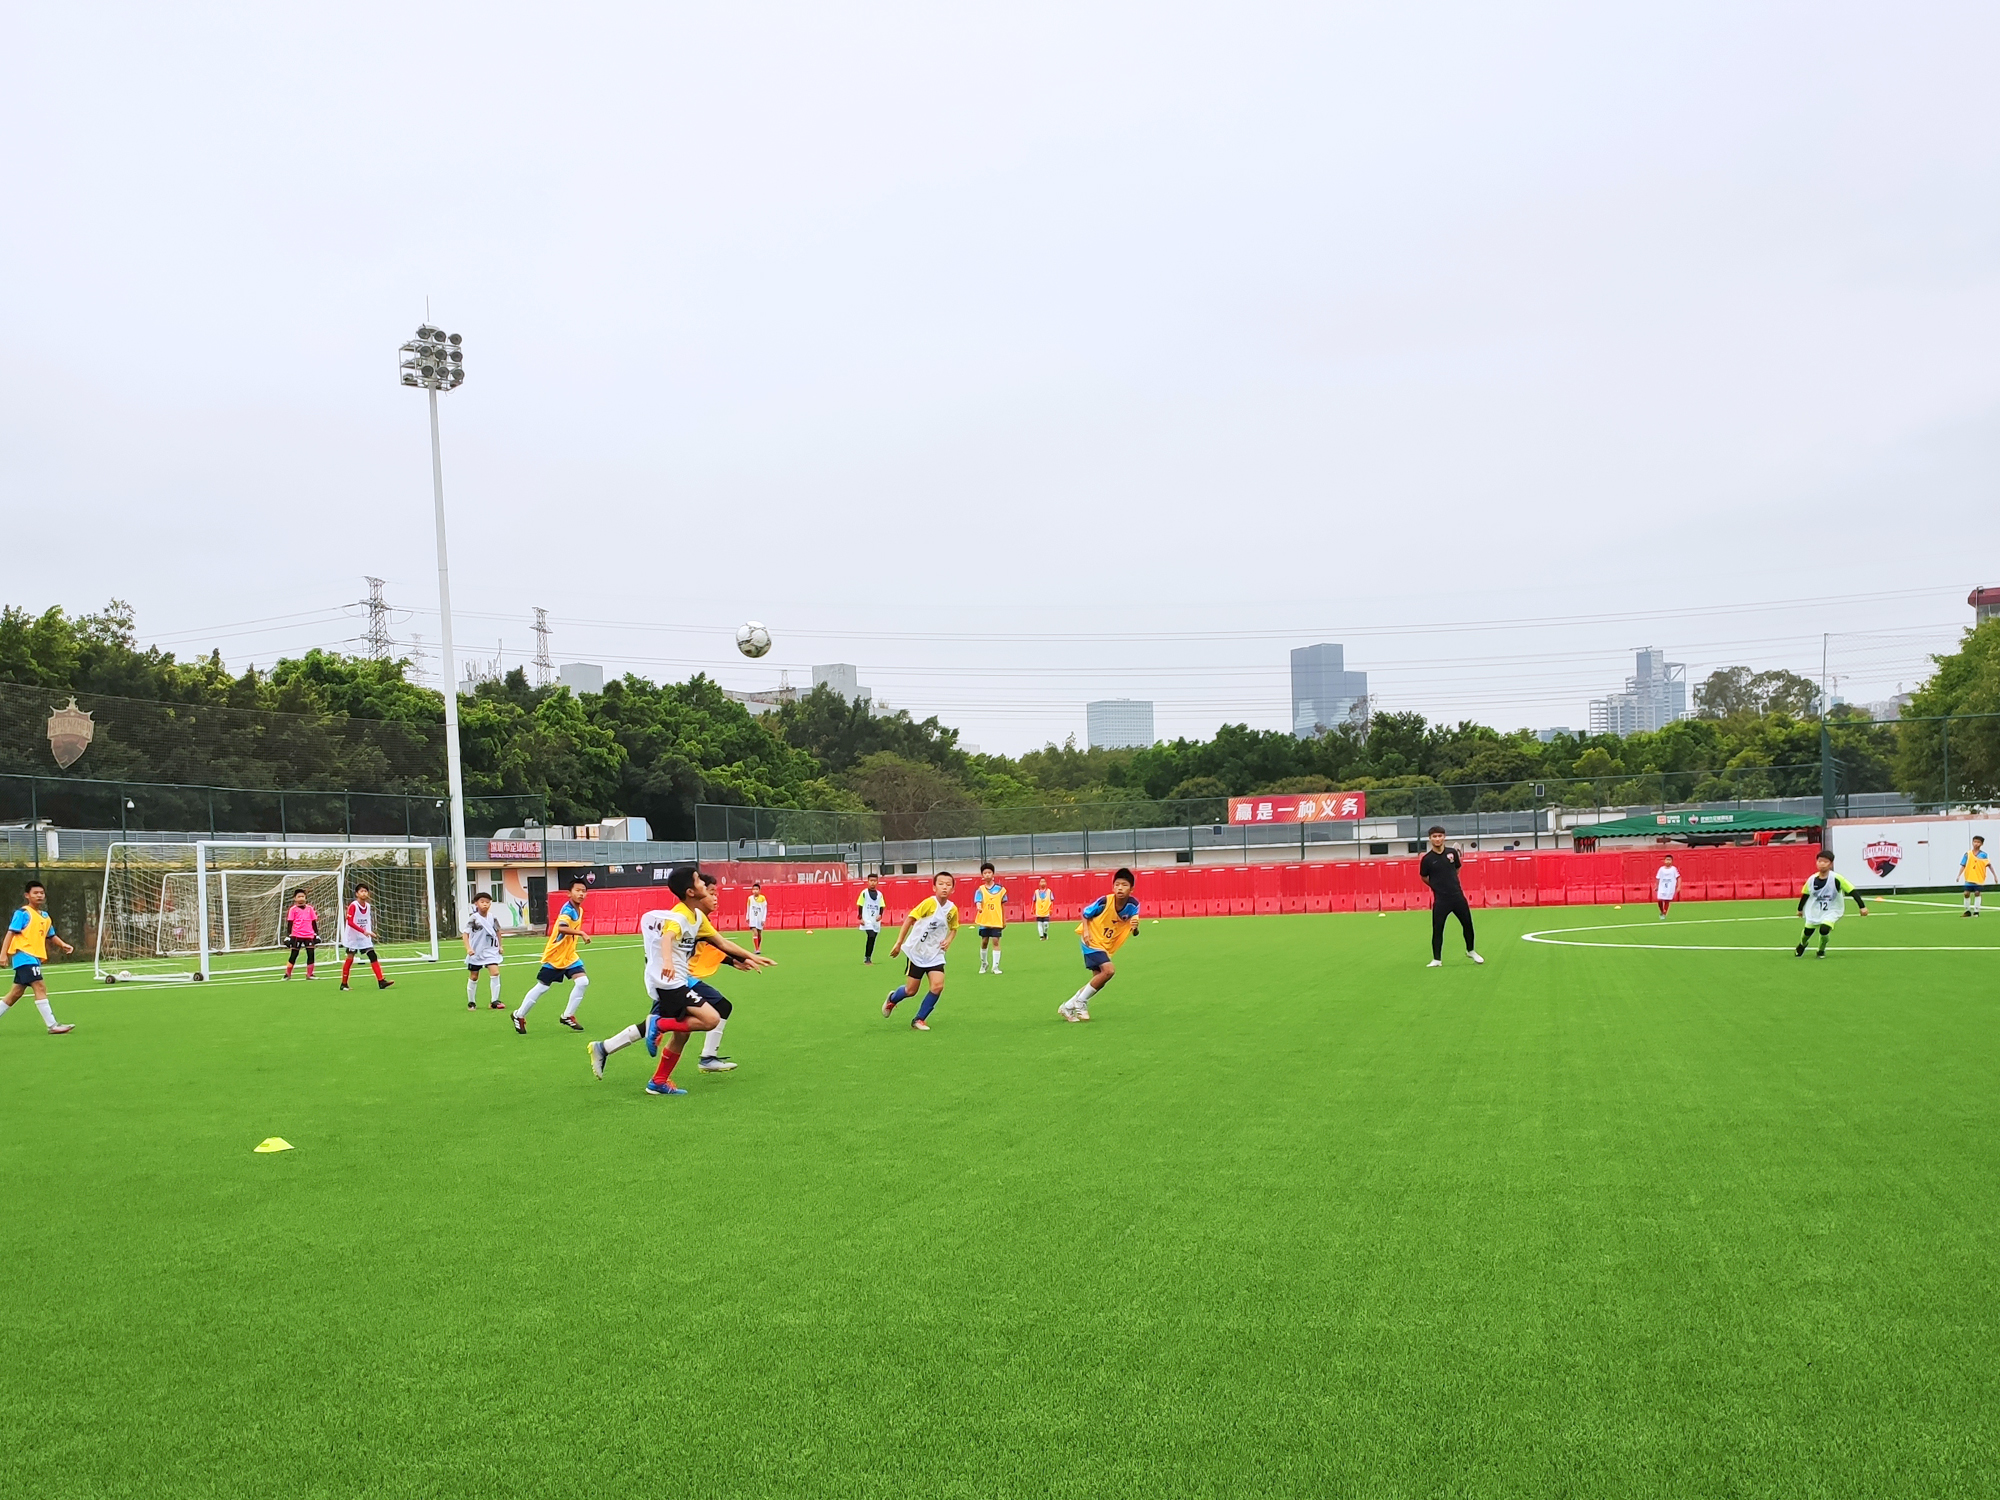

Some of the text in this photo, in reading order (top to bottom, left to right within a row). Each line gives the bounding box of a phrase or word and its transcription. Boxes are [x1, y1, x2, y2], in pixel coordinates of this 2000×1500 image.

[1235, 798, 1358, 820] 赢是一种义务
[1819, 901, 1828, 911] 12
[920, 931, 929, 943] 9
[1103, 928, 1114, 939] 13
[32, 966, 41, 977] 19
